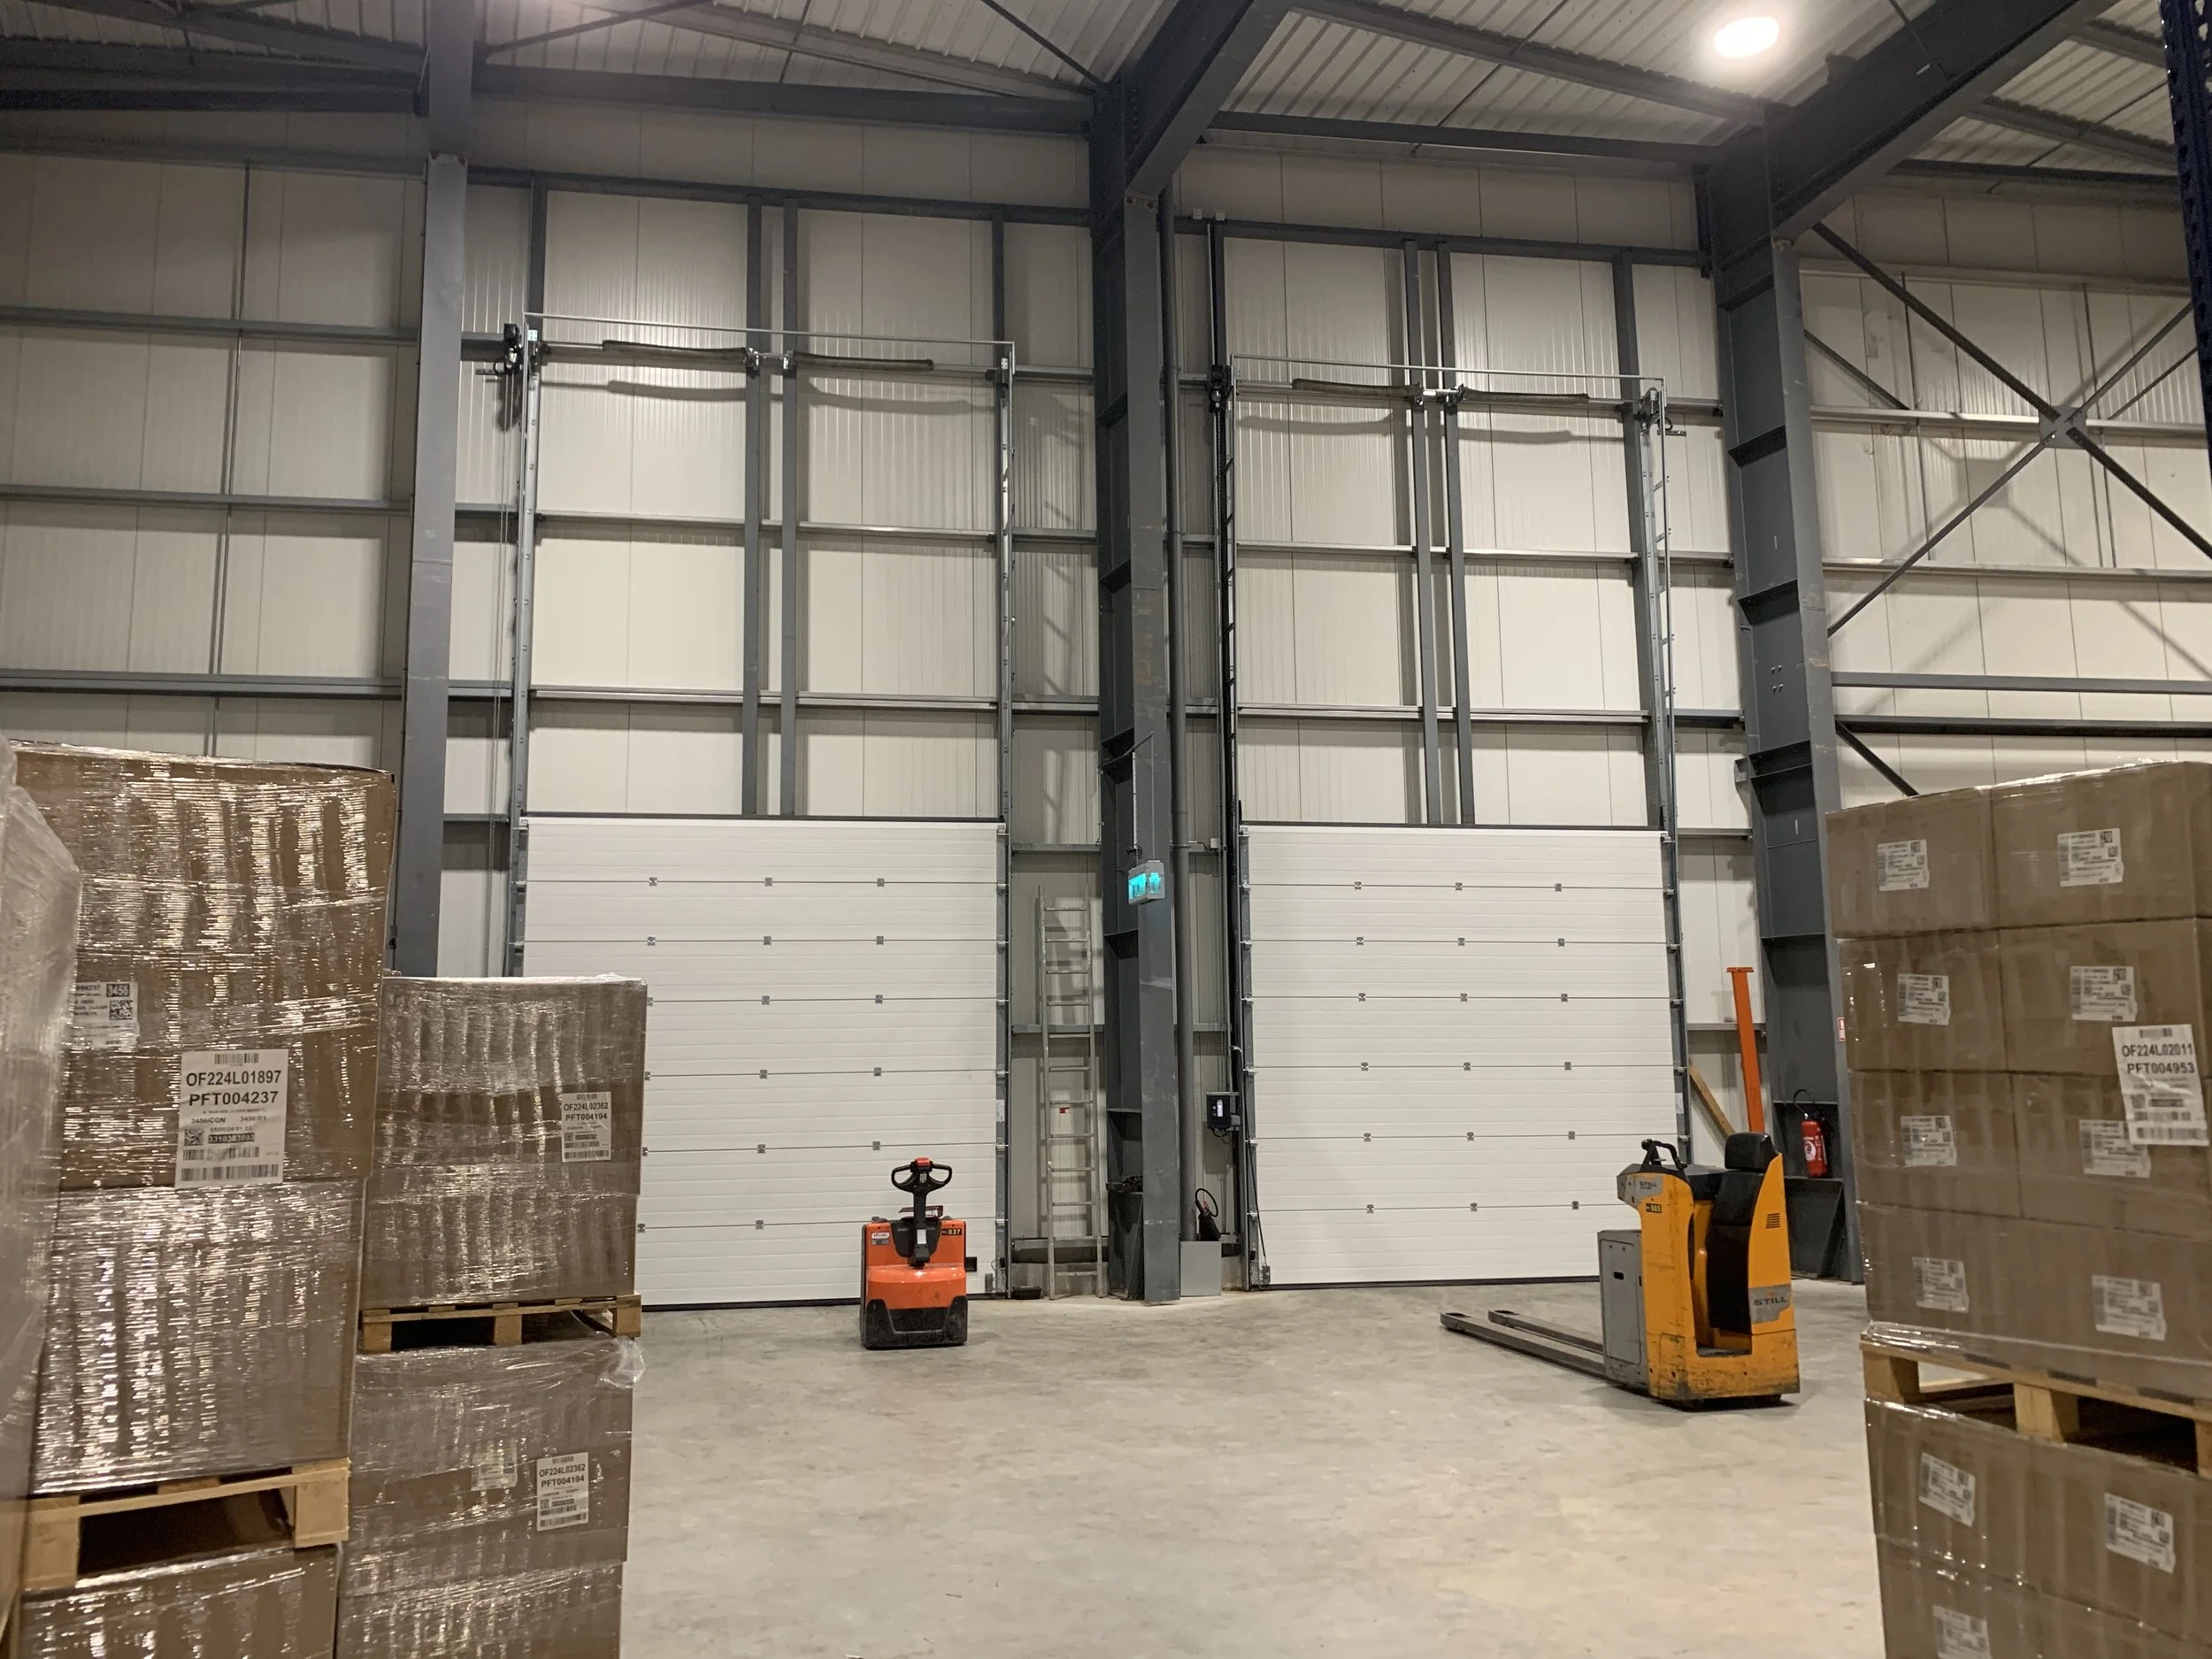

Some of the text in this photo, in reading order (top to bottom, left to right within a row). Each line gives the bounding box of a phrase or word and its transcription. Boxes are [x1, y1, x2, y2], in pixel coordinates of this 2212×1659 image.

[2122, 1043, 2193, 1057] OF224L02011
[2127, 1062, 2195, 1074] PFT004953
[186, 1070, 281, 1087] OF224L01897
[188, 1090, 279, 1106] PFT004237
[564, 1102, 609, 1111] OF224L02362
[565, 1112, 608, 1121] PFT004194
[1755, 1296, 1787, 1306] STILL
[539, 1463, 586, 1478] OF224L02362
[541, 1475, 585, 1487] PFT004194
